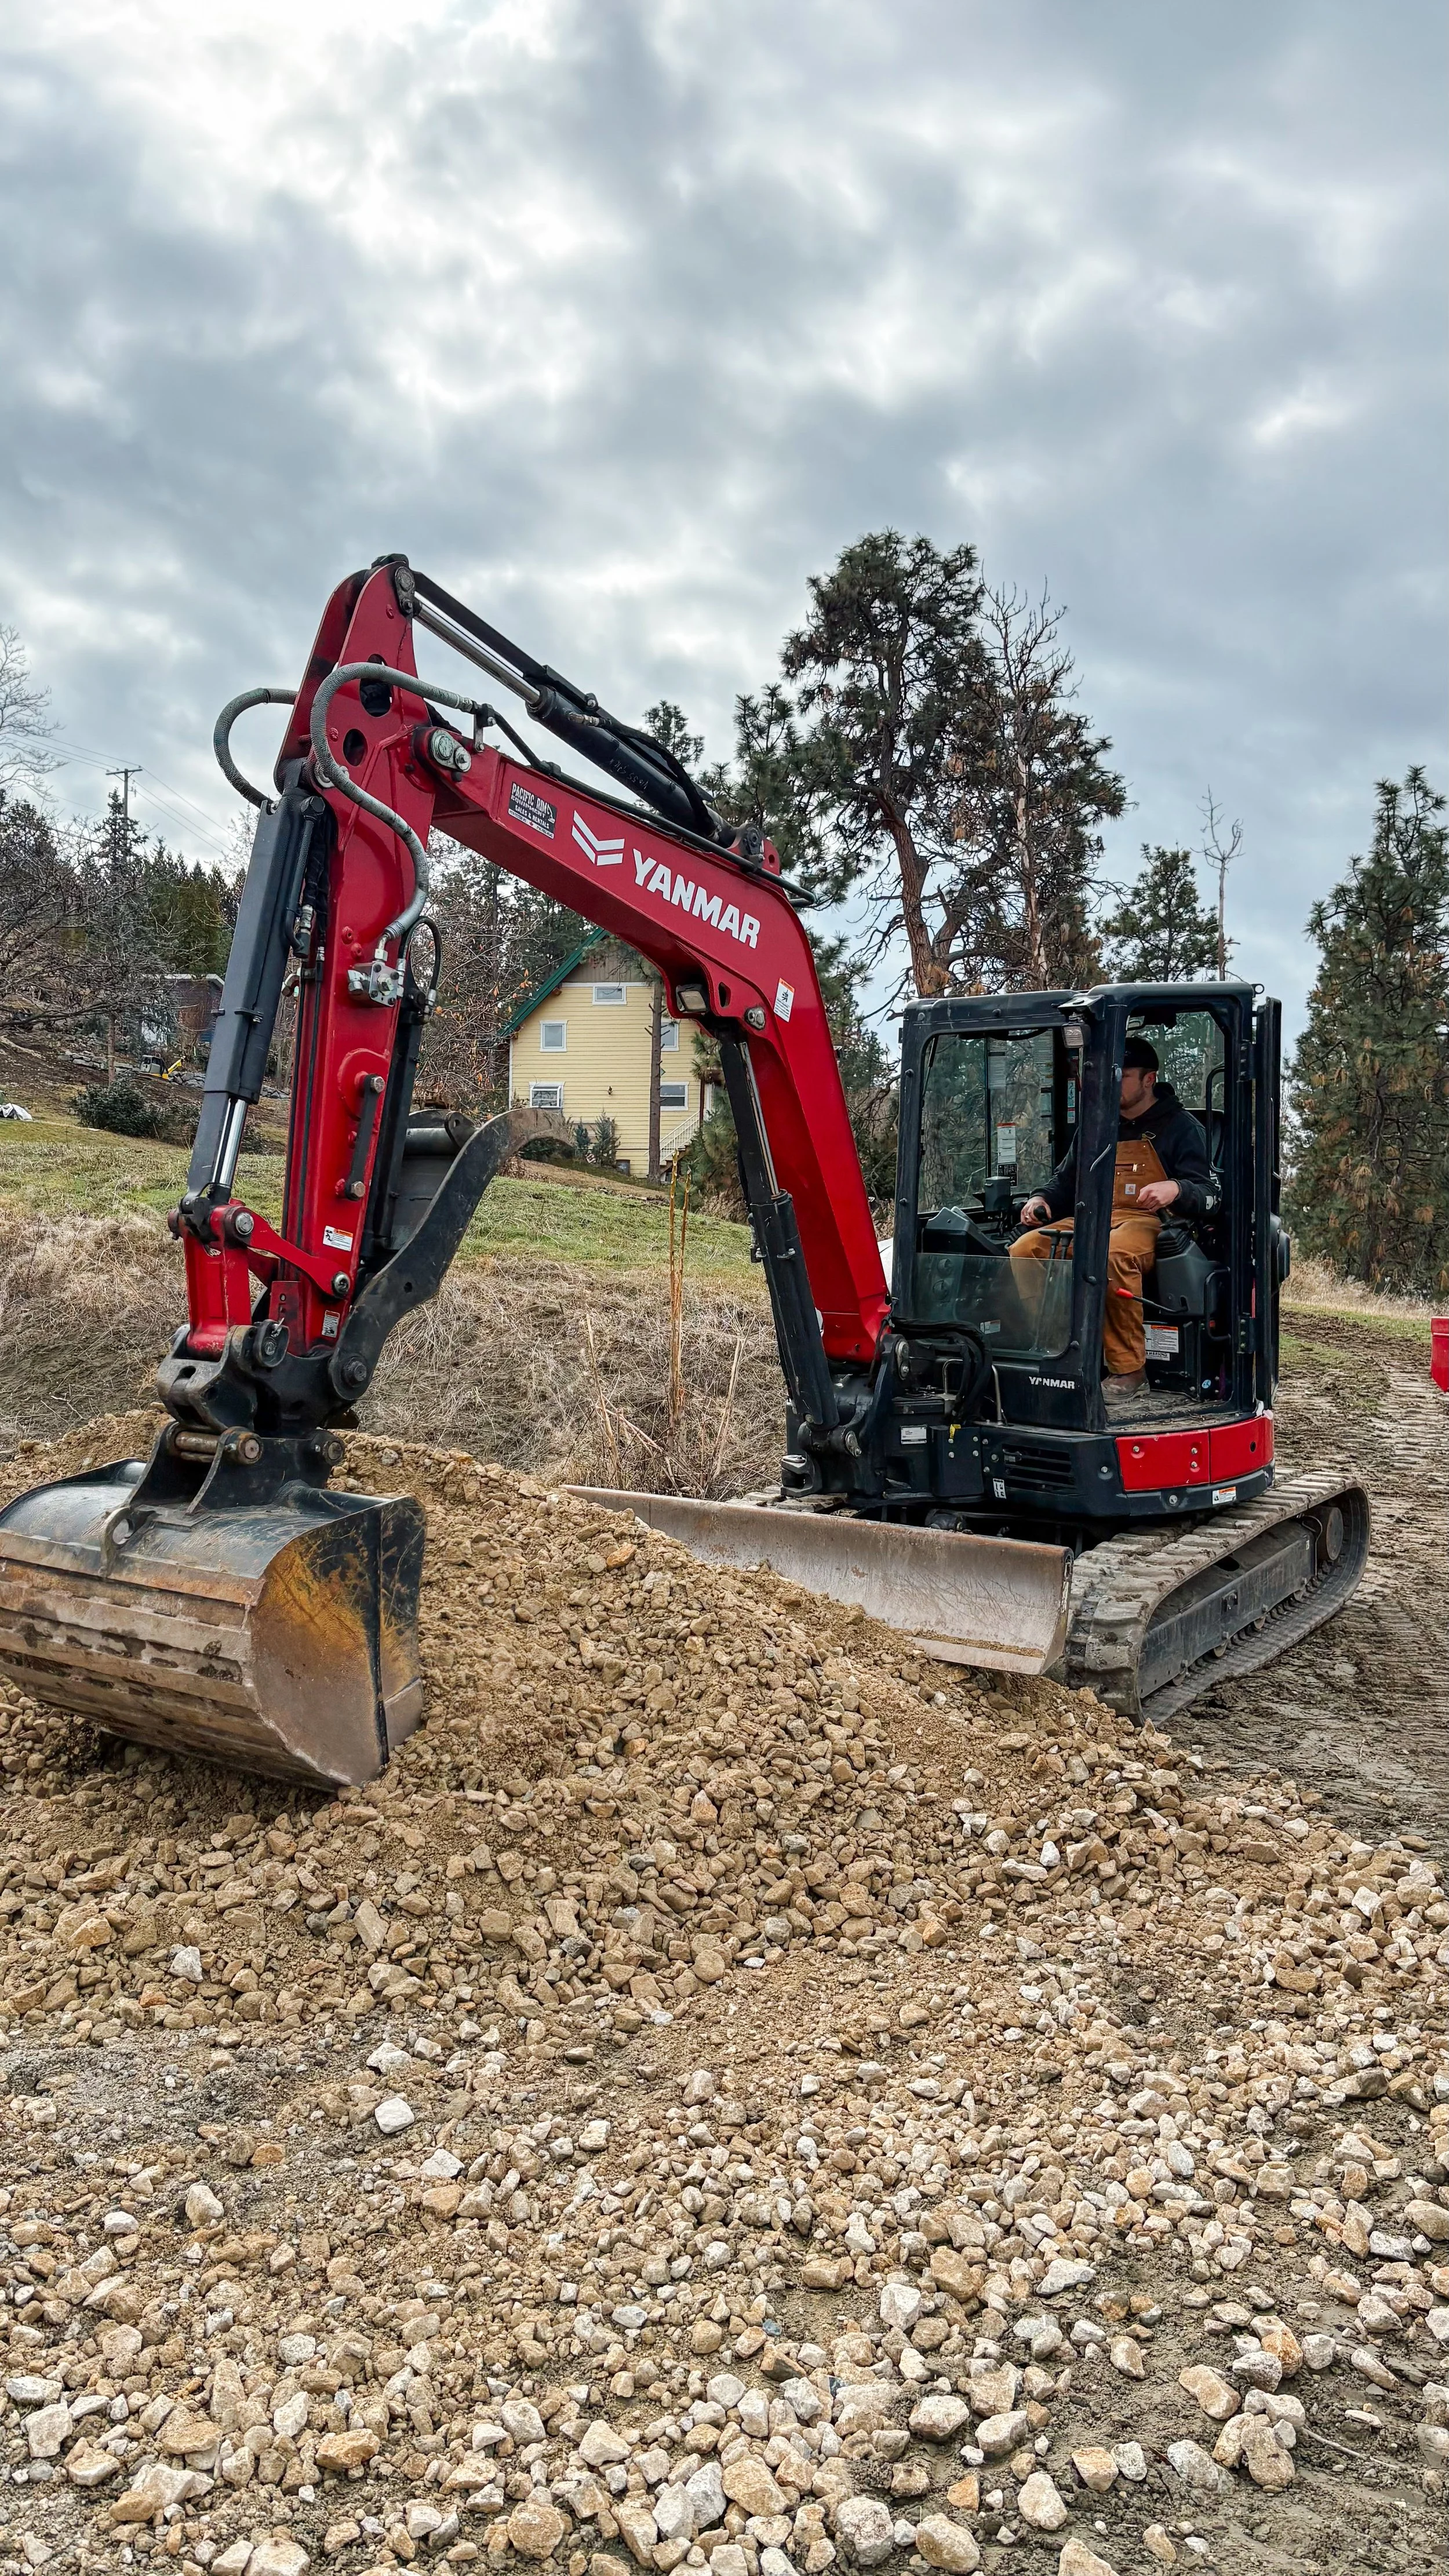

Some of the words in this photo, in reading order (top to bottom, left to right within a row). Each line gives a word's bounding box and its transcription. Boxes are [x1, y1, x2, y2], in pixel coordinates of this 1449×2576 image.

[511, 795, 545, 818] EQUIPMENT
[512, 783, 534, 806] PACIFIC
[536, 797, 547, 814] RIM
[515, 805, 527, 816] SALES
[532, 815, 549, 829] RENTALS
[633, 849, 760, 949] YANMAR
[1029, 1376, 1075, 1389] YANMAR
